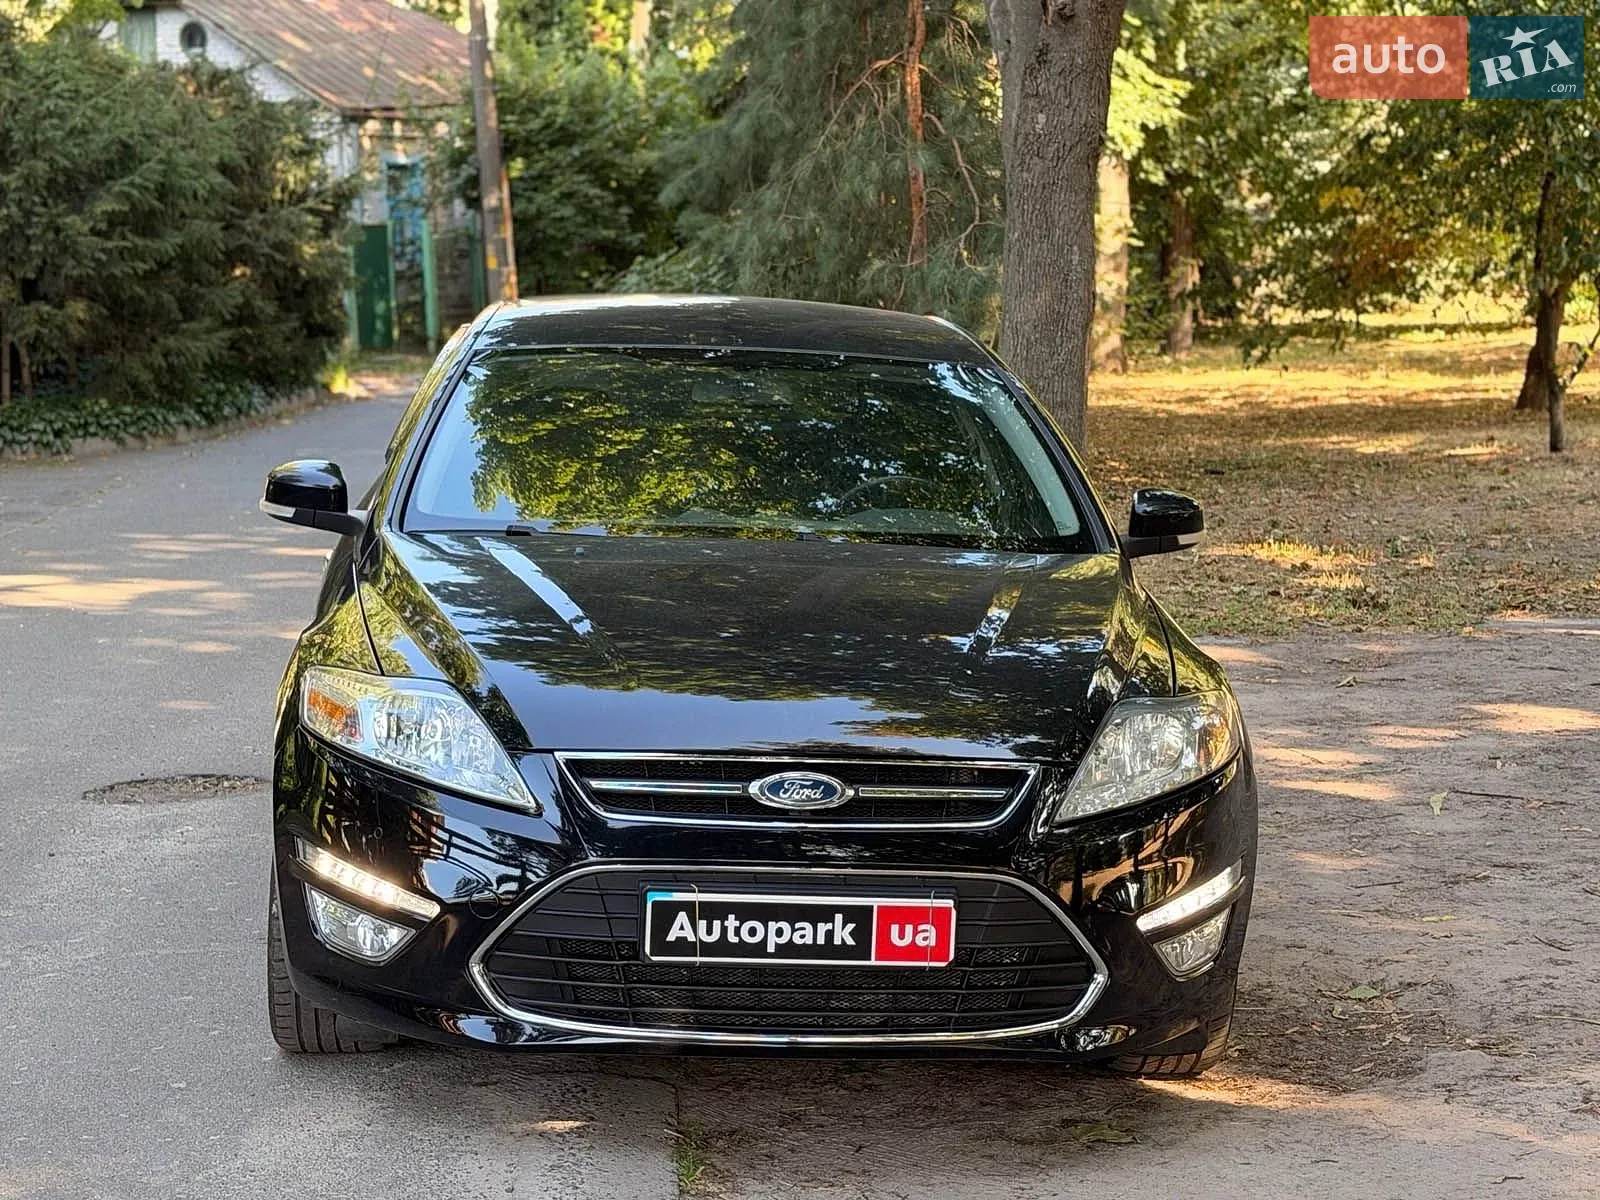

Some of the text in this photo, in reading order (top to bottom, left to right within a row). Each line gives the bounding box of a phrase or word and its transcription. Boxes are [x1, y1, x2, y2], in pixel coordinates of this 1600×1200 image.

[779, 779, 825, 799] Ford
[665, 911, 937, 952] Autopark ua
